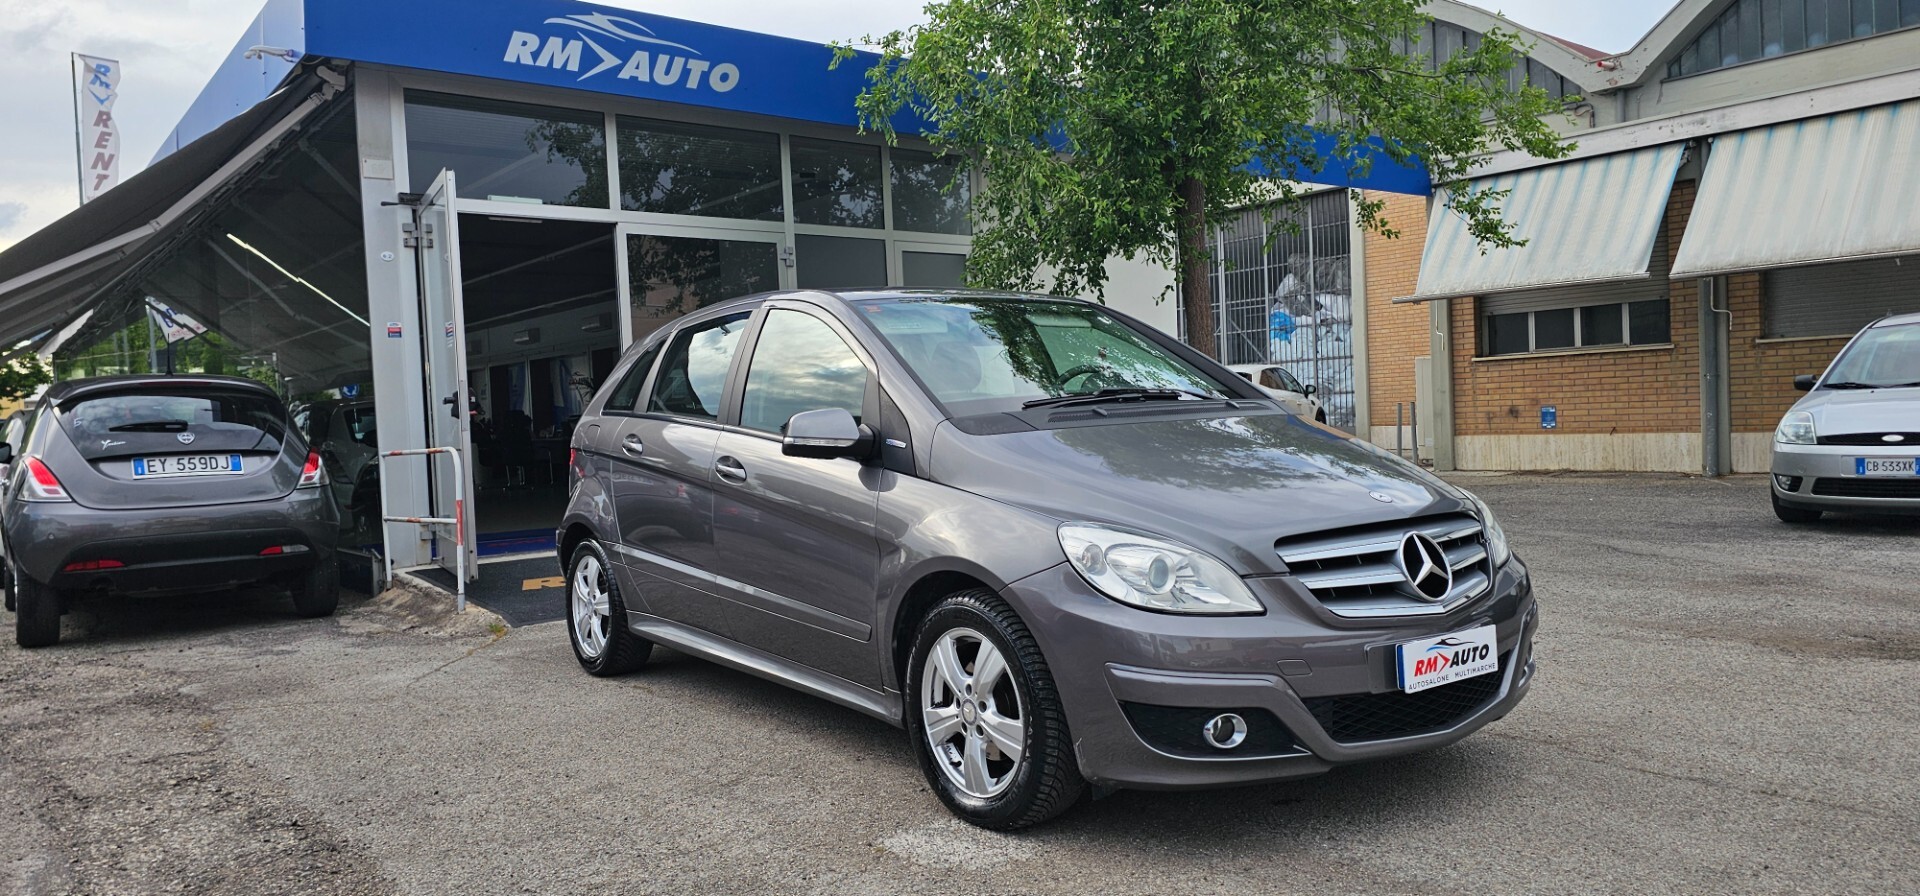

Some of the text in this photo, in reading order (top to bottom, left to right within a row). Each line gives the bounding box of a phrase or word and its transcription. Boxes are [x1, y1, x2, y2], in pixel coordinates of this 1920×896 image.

[503, 30, 740, 93] RM AUTO
[90, 109, 115, 191] RENT
[146, 457, 168, 473] EY
[177, 456, 230, 471] 559DJ
[1866, 461, 1879, 471] CB
[1881, 461, 1915, 471] 533XK
[1414, 643, 1489, 677] RM AUTO
[1408, 662, 1496, 690] AUTOSALONE MULTIMARCHE
